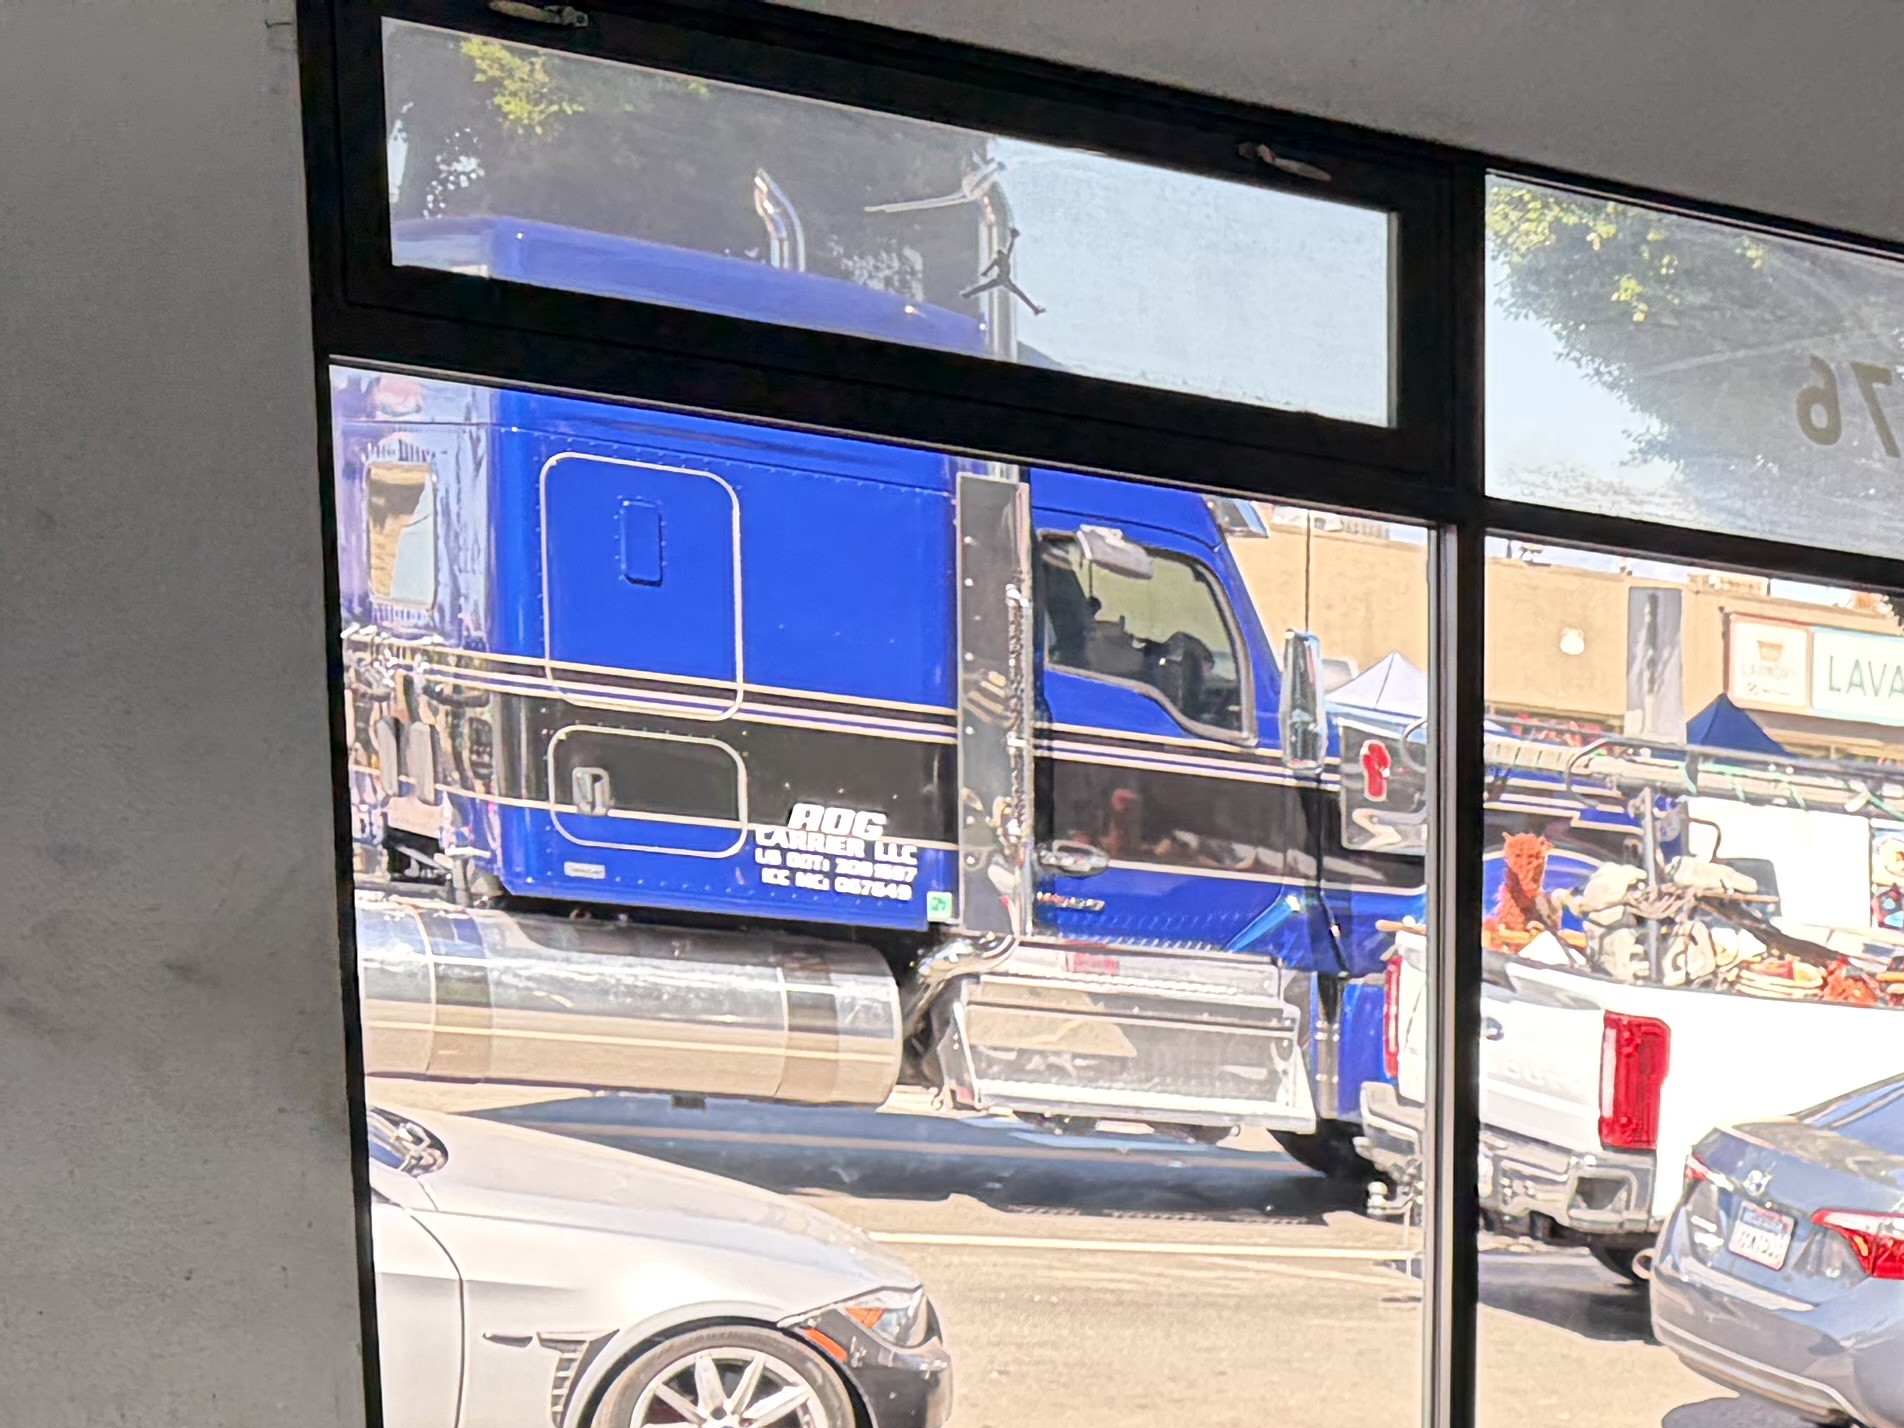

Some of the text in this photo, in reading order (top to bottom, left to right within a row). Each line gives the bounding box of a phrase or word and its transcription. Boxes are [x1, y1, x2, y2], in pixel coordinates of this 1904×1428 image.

[788, 803, 888, 841] AOG
[755, 829, 918, 865] CARRIER LLC
